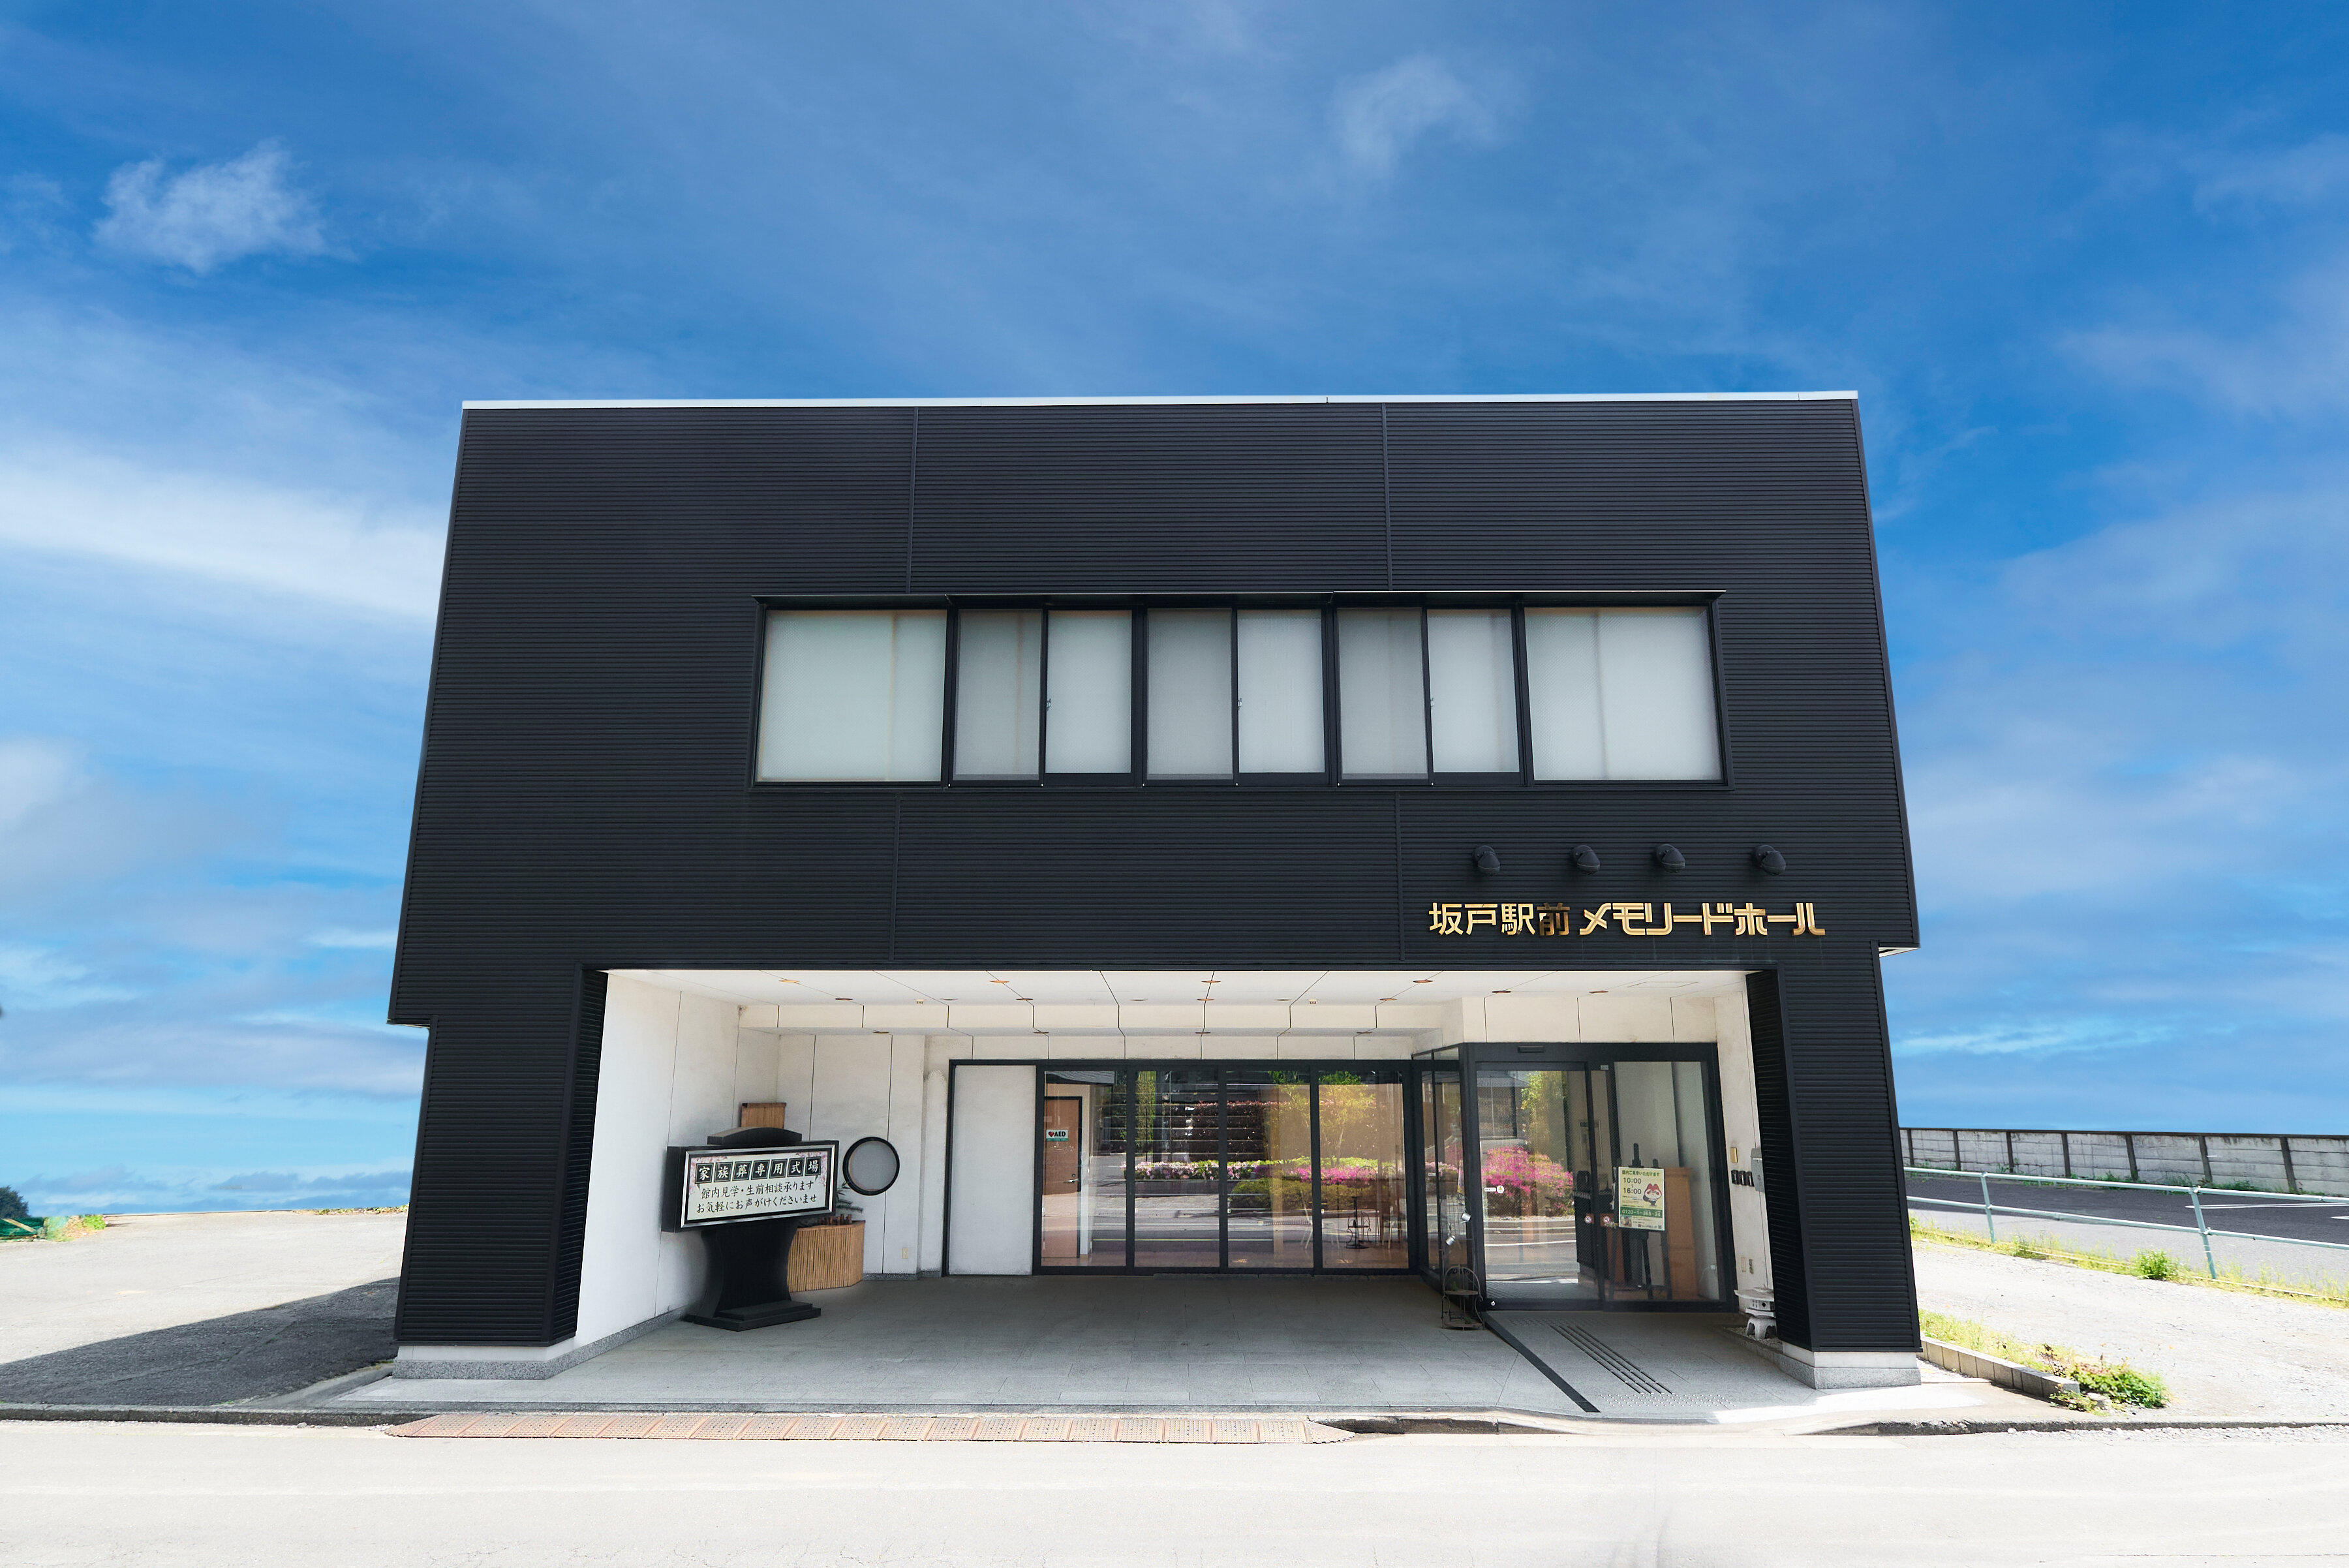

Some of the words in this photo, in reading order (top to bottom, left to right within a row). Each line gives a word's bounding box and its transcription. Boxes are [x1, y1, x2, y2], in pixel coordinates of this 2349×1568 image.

[1429, 902, 1570, 936] 坂戸駅前
[1579, 902, 1826, 936] メモリードホール
[699, 1160, 819, 1181] 家族葬専用式場
[701, 1180, 814, 1199] 館内見学・生前相談承ります
[696, 1193, 817, 1214] お気軽にお声がけくださいませ
